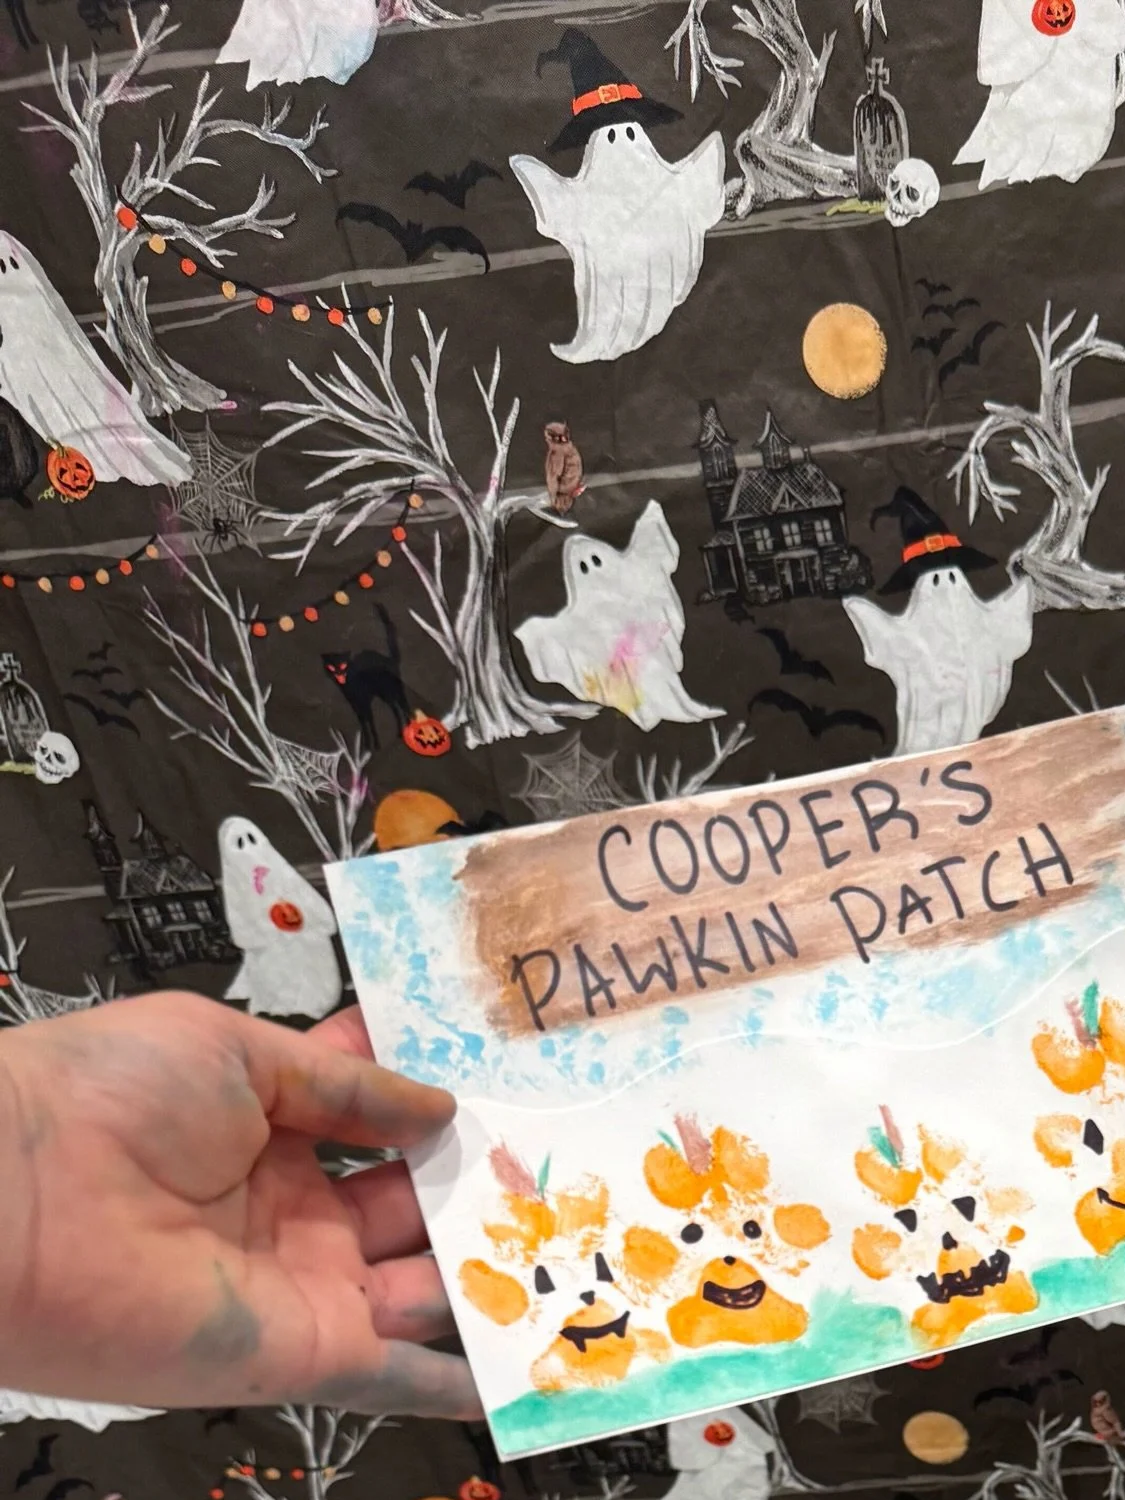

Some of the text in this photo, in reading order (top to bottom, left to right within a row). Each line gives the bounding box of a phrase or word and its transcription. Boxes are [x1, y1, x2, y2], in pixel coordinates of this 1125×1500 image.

[510, 821, 1075, 1032] PAWKIN PATCH
[598, 760, 993, 912] COOPER'S
